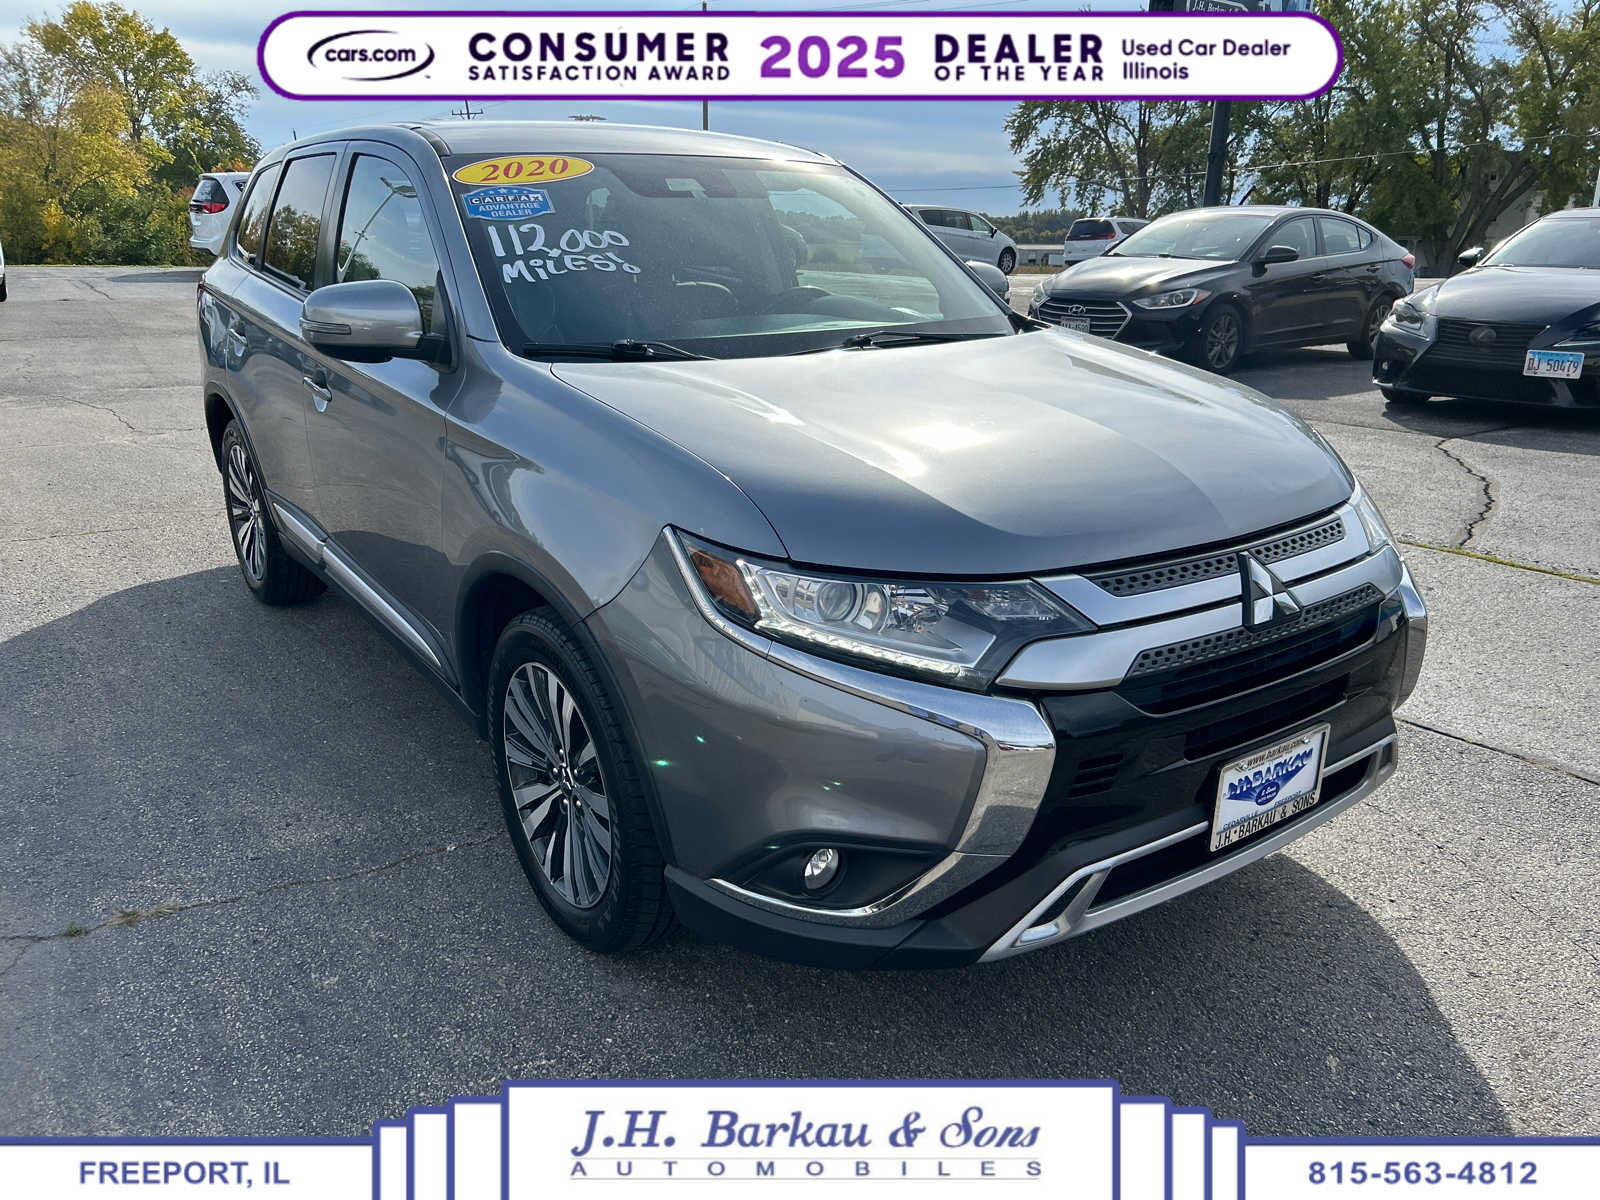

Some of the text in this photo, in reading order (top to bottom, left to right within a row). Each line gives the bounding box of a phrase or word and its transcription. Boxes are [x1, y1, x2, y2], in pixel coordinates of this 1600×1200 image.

[480, 158, 569, 182] 2020
[470, 193, 544, 205] CARFAX
[479, 202, 541, 212] ADVANTAGE
[491, 209, 533, 218] DEALER
[487, 223, 630, 257] 112,000
[1546, 358, 1579, 374] 50479
[1238, 809, 1277, 838] BARKAU
[1280, 804, 1287, 818] &
[1291, 791, 1316, 814] SONS
